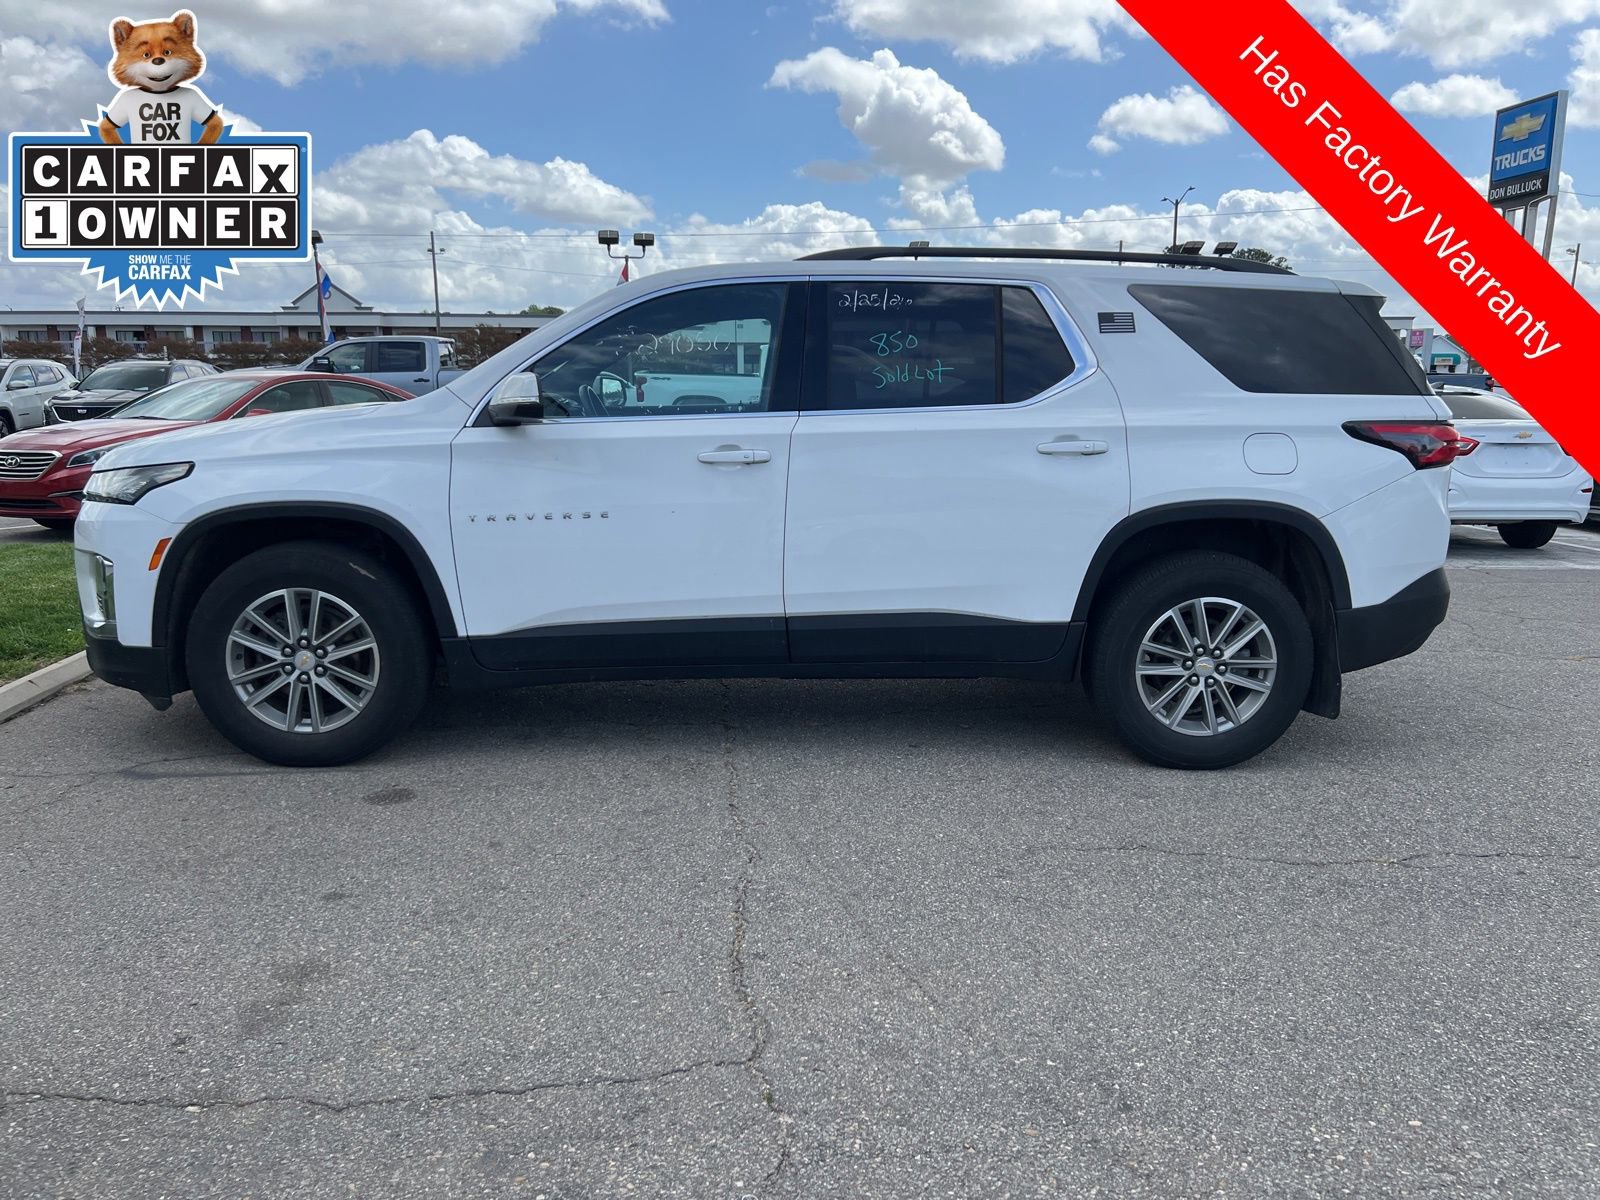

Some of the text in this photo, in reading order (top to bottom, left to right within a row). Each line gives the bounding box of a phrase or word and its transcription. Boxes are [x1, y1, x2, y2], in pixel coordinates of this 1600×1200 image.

[1495, 144, 1546, 171] TRUCKS
[1490, 179, 1542, 200] DON BULLUCK
[869, 331, 918, 356] 850
[468, 512, 609, 522] TRAVERSE
